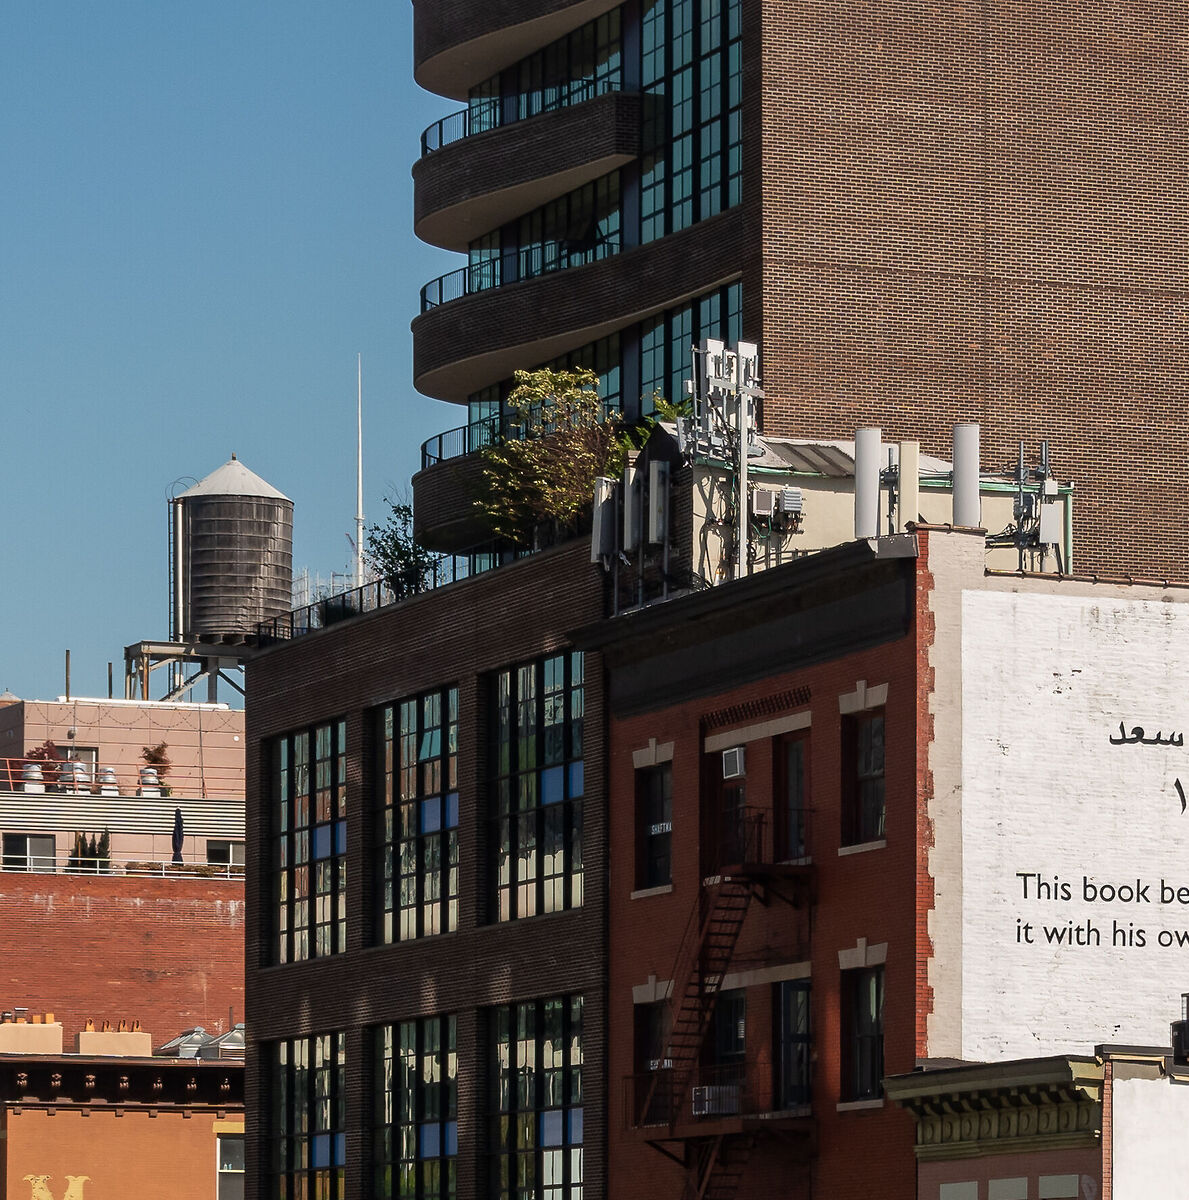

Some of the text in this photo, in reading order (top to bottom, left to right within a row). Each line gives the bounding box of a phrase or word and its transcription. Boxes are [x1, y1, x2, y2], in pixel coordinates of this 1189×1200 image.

[1109, 720, 1184, 747] سعد
[1015, 872, 1072, 901] This
[1083, 875, 1151, 903] book
[1016, 918, 1034, 944] it
[1043, 918, 1101, 946] with
[1112, 919, 1147, 948] his
